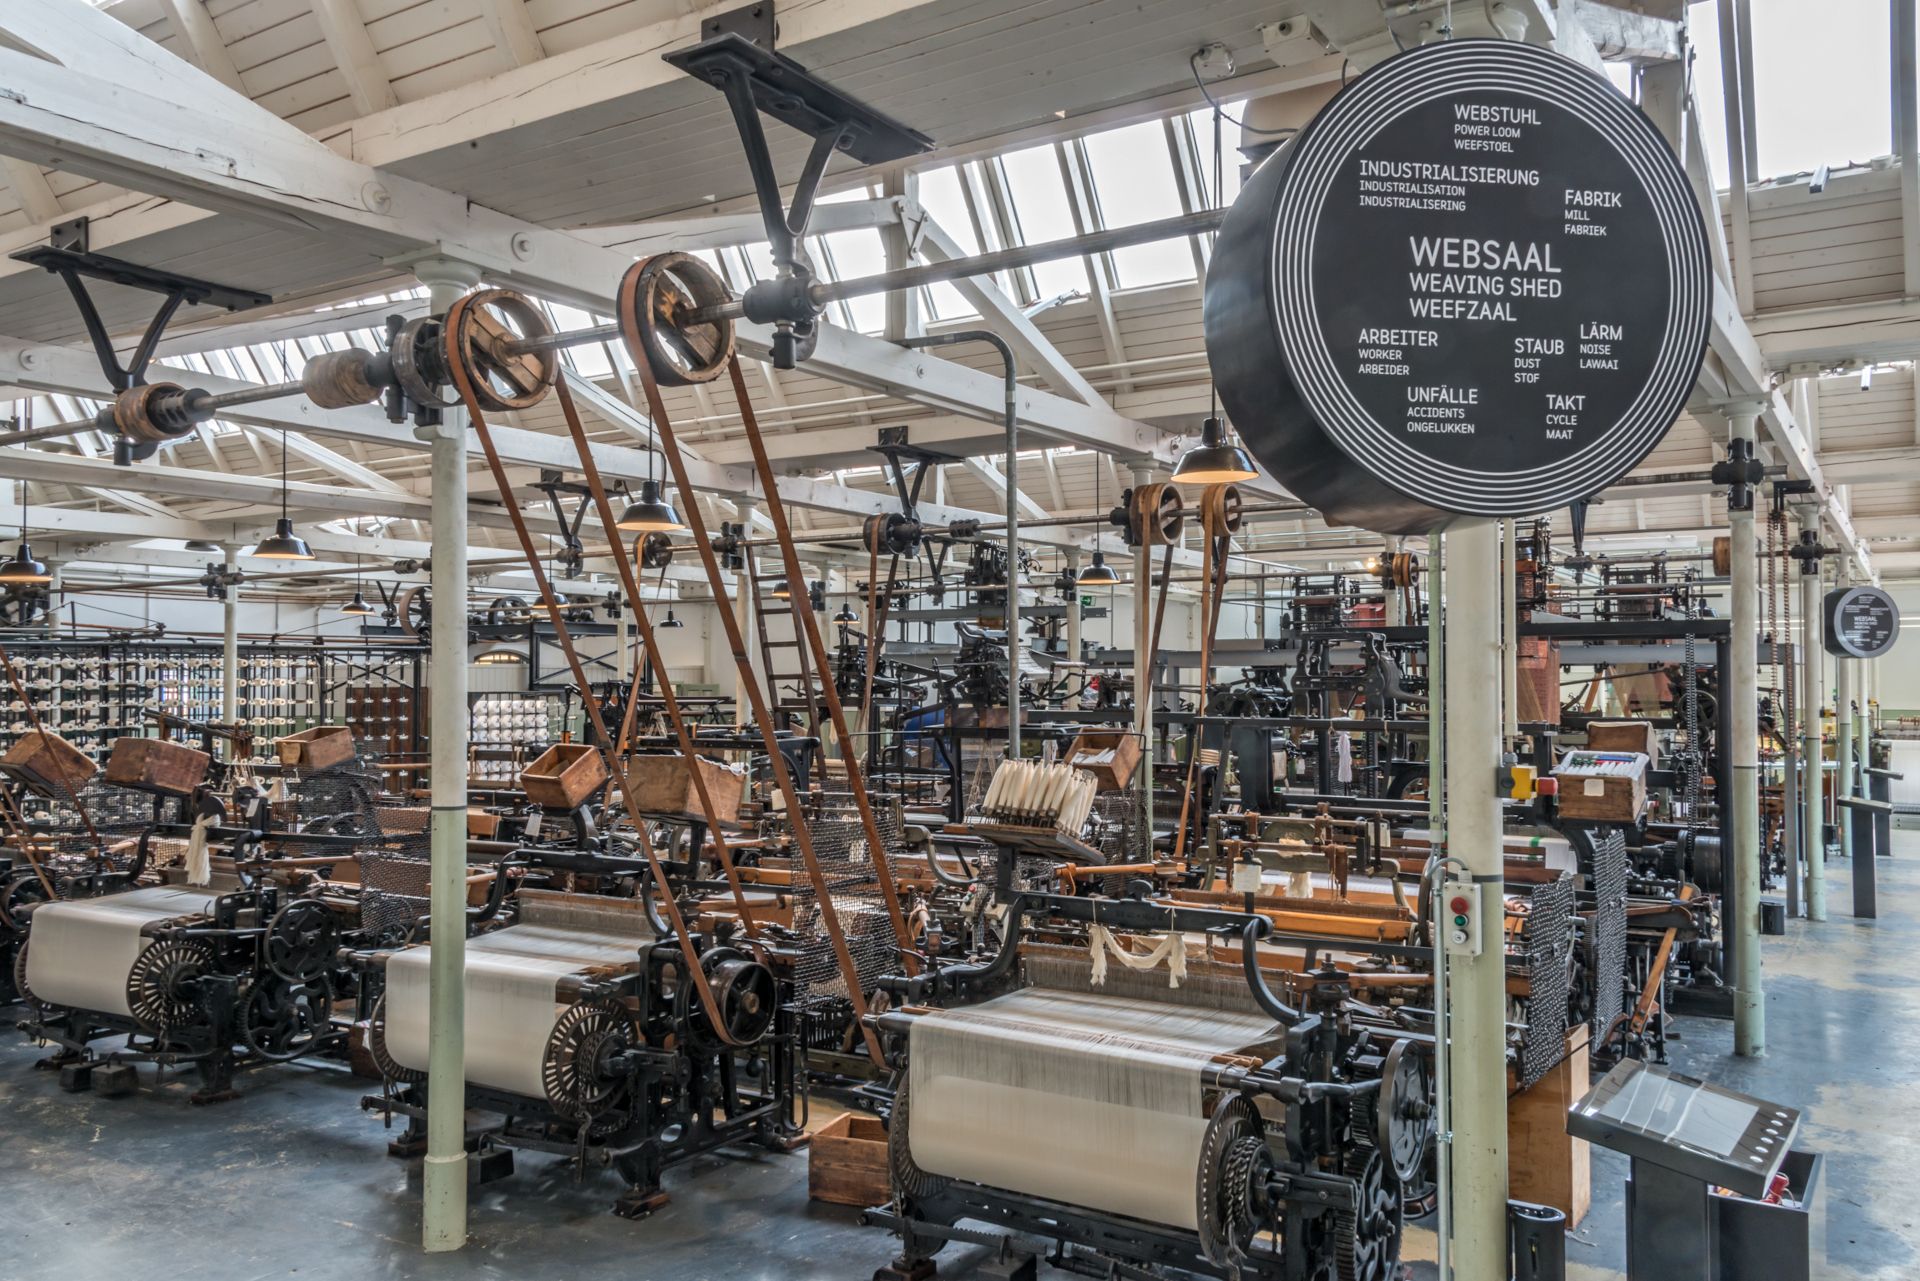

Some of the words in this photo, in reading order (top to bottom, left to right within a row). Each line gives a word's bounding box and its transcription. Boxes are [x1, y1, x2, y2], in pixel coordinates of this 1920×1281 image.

[1454, 104, 1541, 125] WEBSTUHL
[1454, 124, 1490, 136] POWER
[1492, 127, 1521, 138] LOOM
[1454, 139, 1514, 153] WEEFSTOEL
[1359, 160, 1540, 186] INDUSTRIALISIERUNG
[1359, 180, 1466, 196] INDUSTRIALISATION
[1359, 195, 1466, 211] INDUSTRIALISERING
[1565, 190, 1622, 208] FABRIK
[1565, 210, 1590, 221] MILL
[1564, 224, 1607, 236] FABRIEK
[1409, 236, 1562, 273] WEBSAAL
[1409, 273, 1504, 295] WEAVING
[1510, 277, 1562, 298] SHED
[1409, 298, 1517, 321] WEEFZAAL
[1358, 328, 1439, 347] ARBEITER
[1580, 322, 1623, 340] LÄRM
[1514, 338, 1565, 355] STAUB
[1580, 344, 1611, 355] NOISE
[1358, 349, 1402, 360] WORKER
[1358, 364, 1410, 376] ARBEIDER
[1514, 358, 1541, 369] DUST
[1580, 359, 1619, 370] LAWAAI
[1514, 373, 1540, 383] STOF
[1407, 386, 1479, 404] UNFÄLLE
[1546, 394, 1586, 411] TAKT
[1407, 407, 1465, 419] ACCIDENTS
[1546, 415, 1578, 426] CYCLE
[1407, 422, 1475, 434] ONGELUKKEN
[1546, 430, 1573, 440] MAAT
